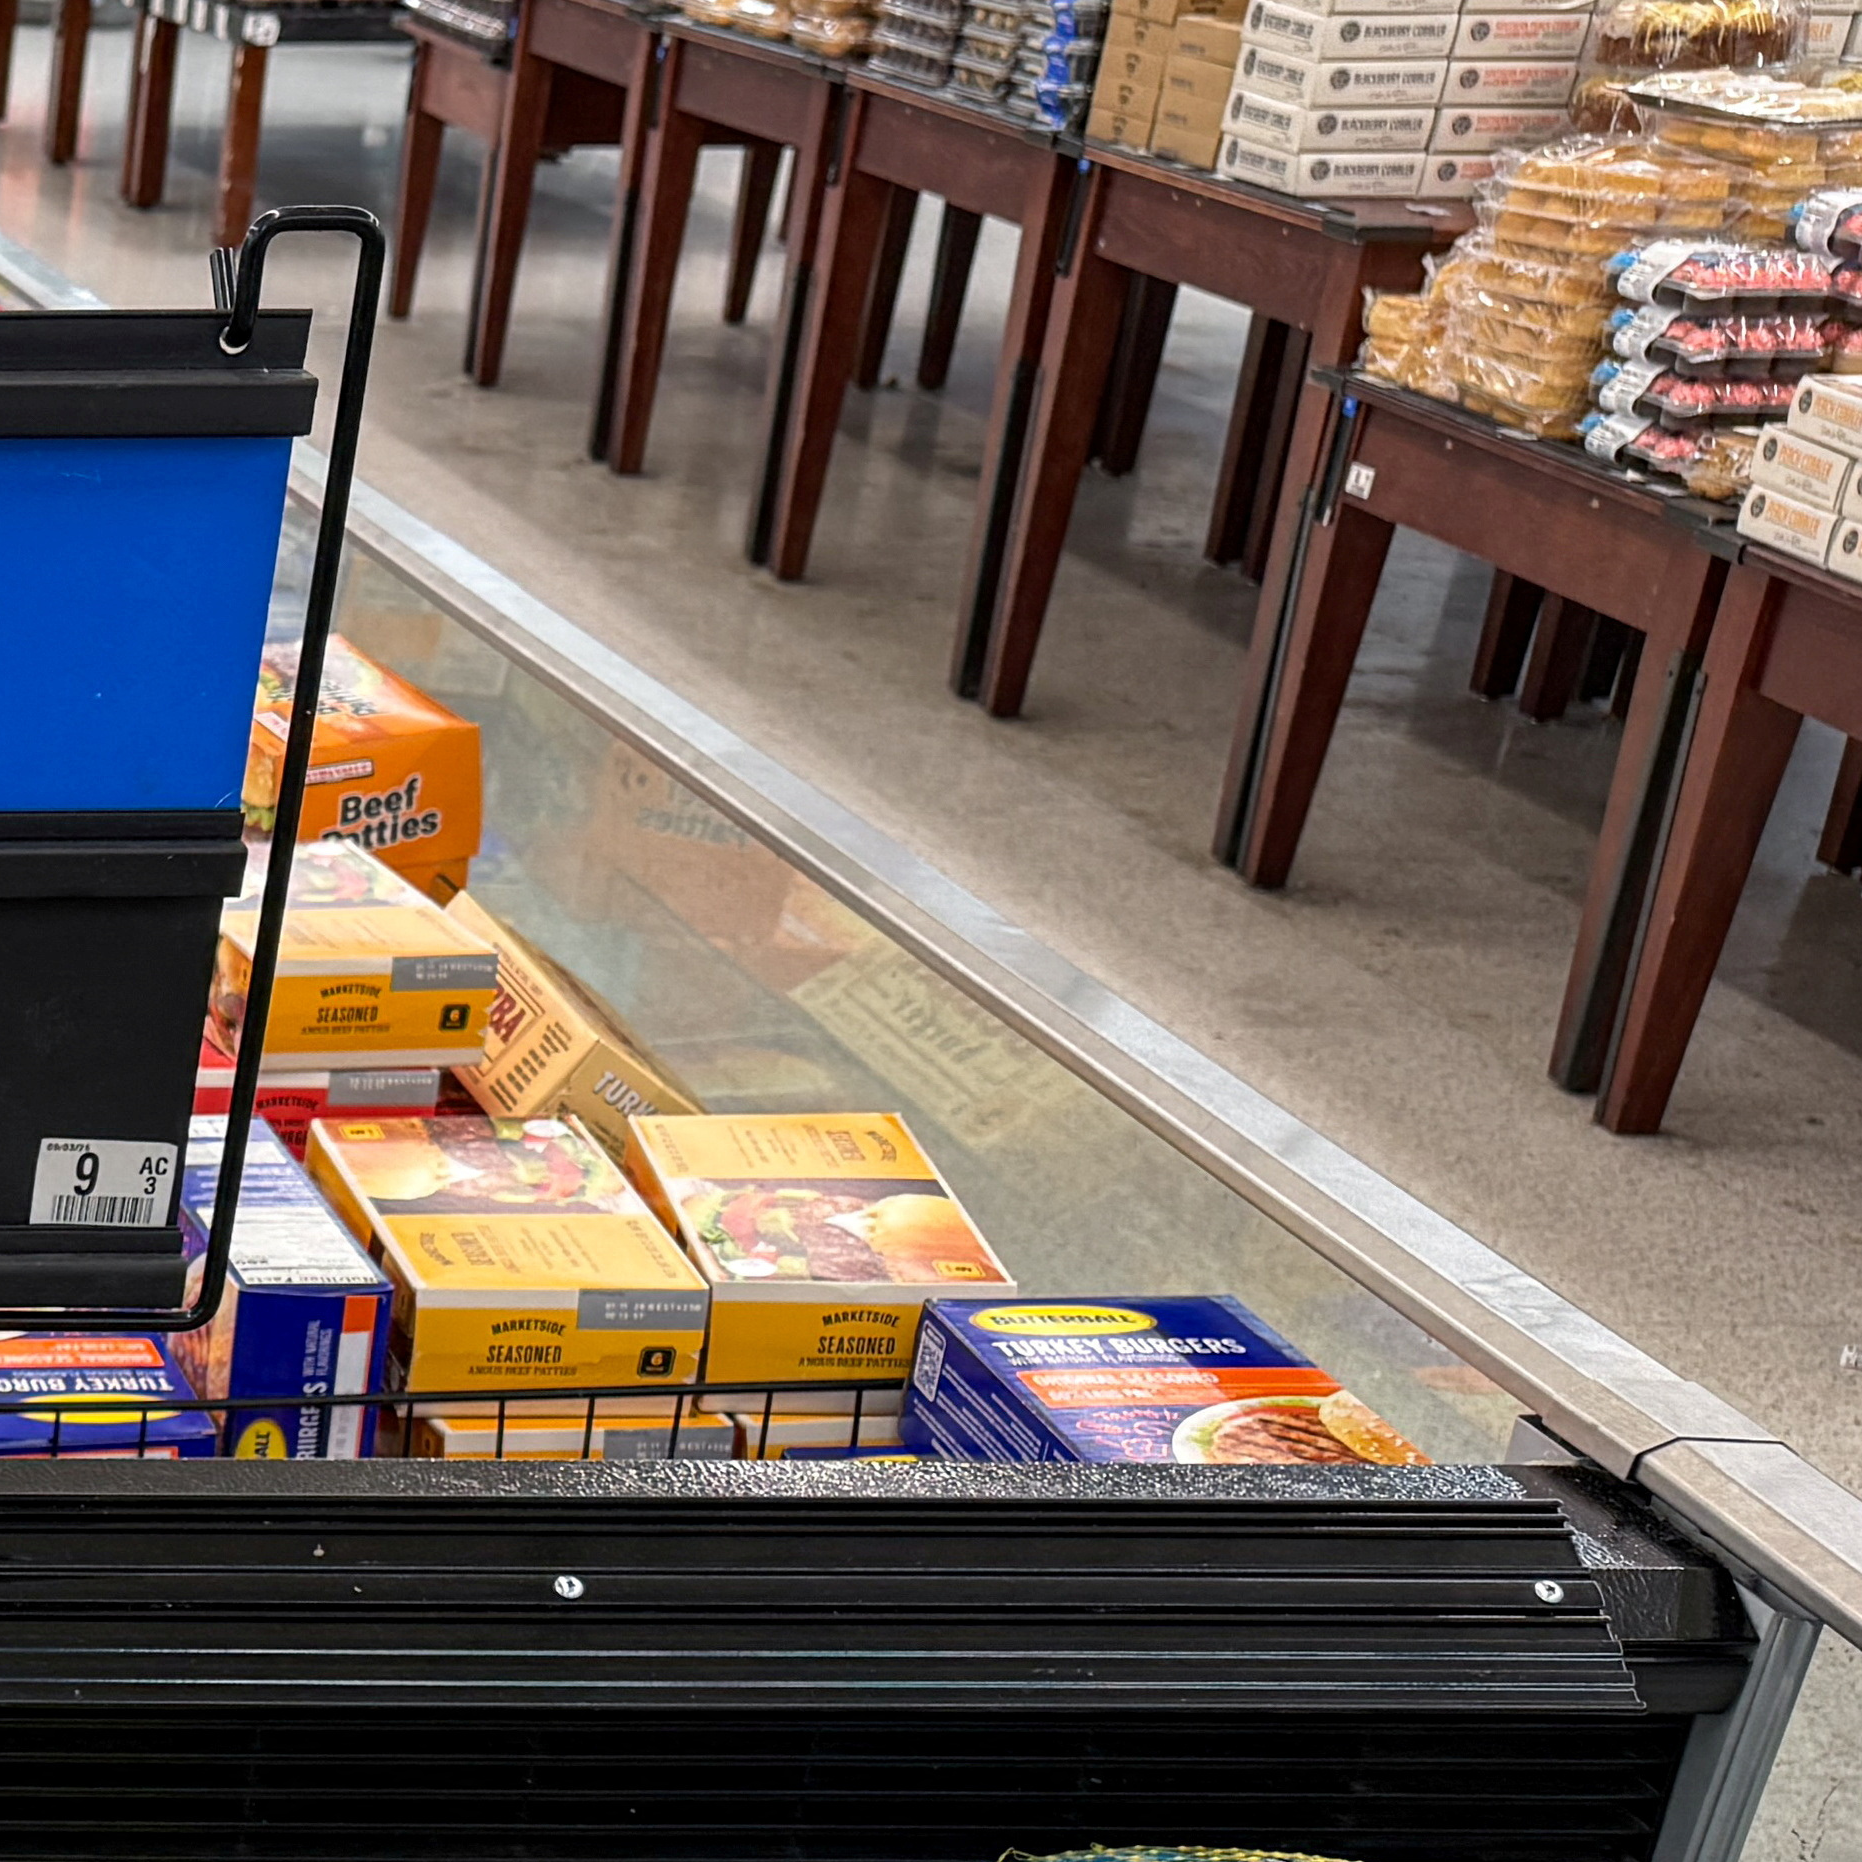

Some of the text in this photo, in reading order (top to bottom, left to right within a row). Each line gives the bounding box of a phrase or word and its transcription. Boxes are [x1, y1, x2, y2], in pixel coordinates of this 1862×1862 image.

[1412, 25, 1446, 37] COBBLER
[1401, 73, 1436, 84] COBBLER
[339, 775, 419, 828] Beef
[319, 984, 382, 999] MARKETSIDE
[316, 1005, 378, 1024] SEASONED
[74, 1152, 168, 1195] 9 AC
[144, 1177, 156, 1194] 3
[822, 1309, 900, 1328] MARKETSIDE
[990, 1315, 1138, 1325] BUTTERBALL
[491, 1319, 567, 1337] MARKETSIDE
[486, 1345, 562, 1364] SEASONED
[817, 1336, 896, 1355] SEASONED
[993, 1339, 1246, 1357] TURKEY BURGERS
[75, 1376, 174, 1392] TURKEY
